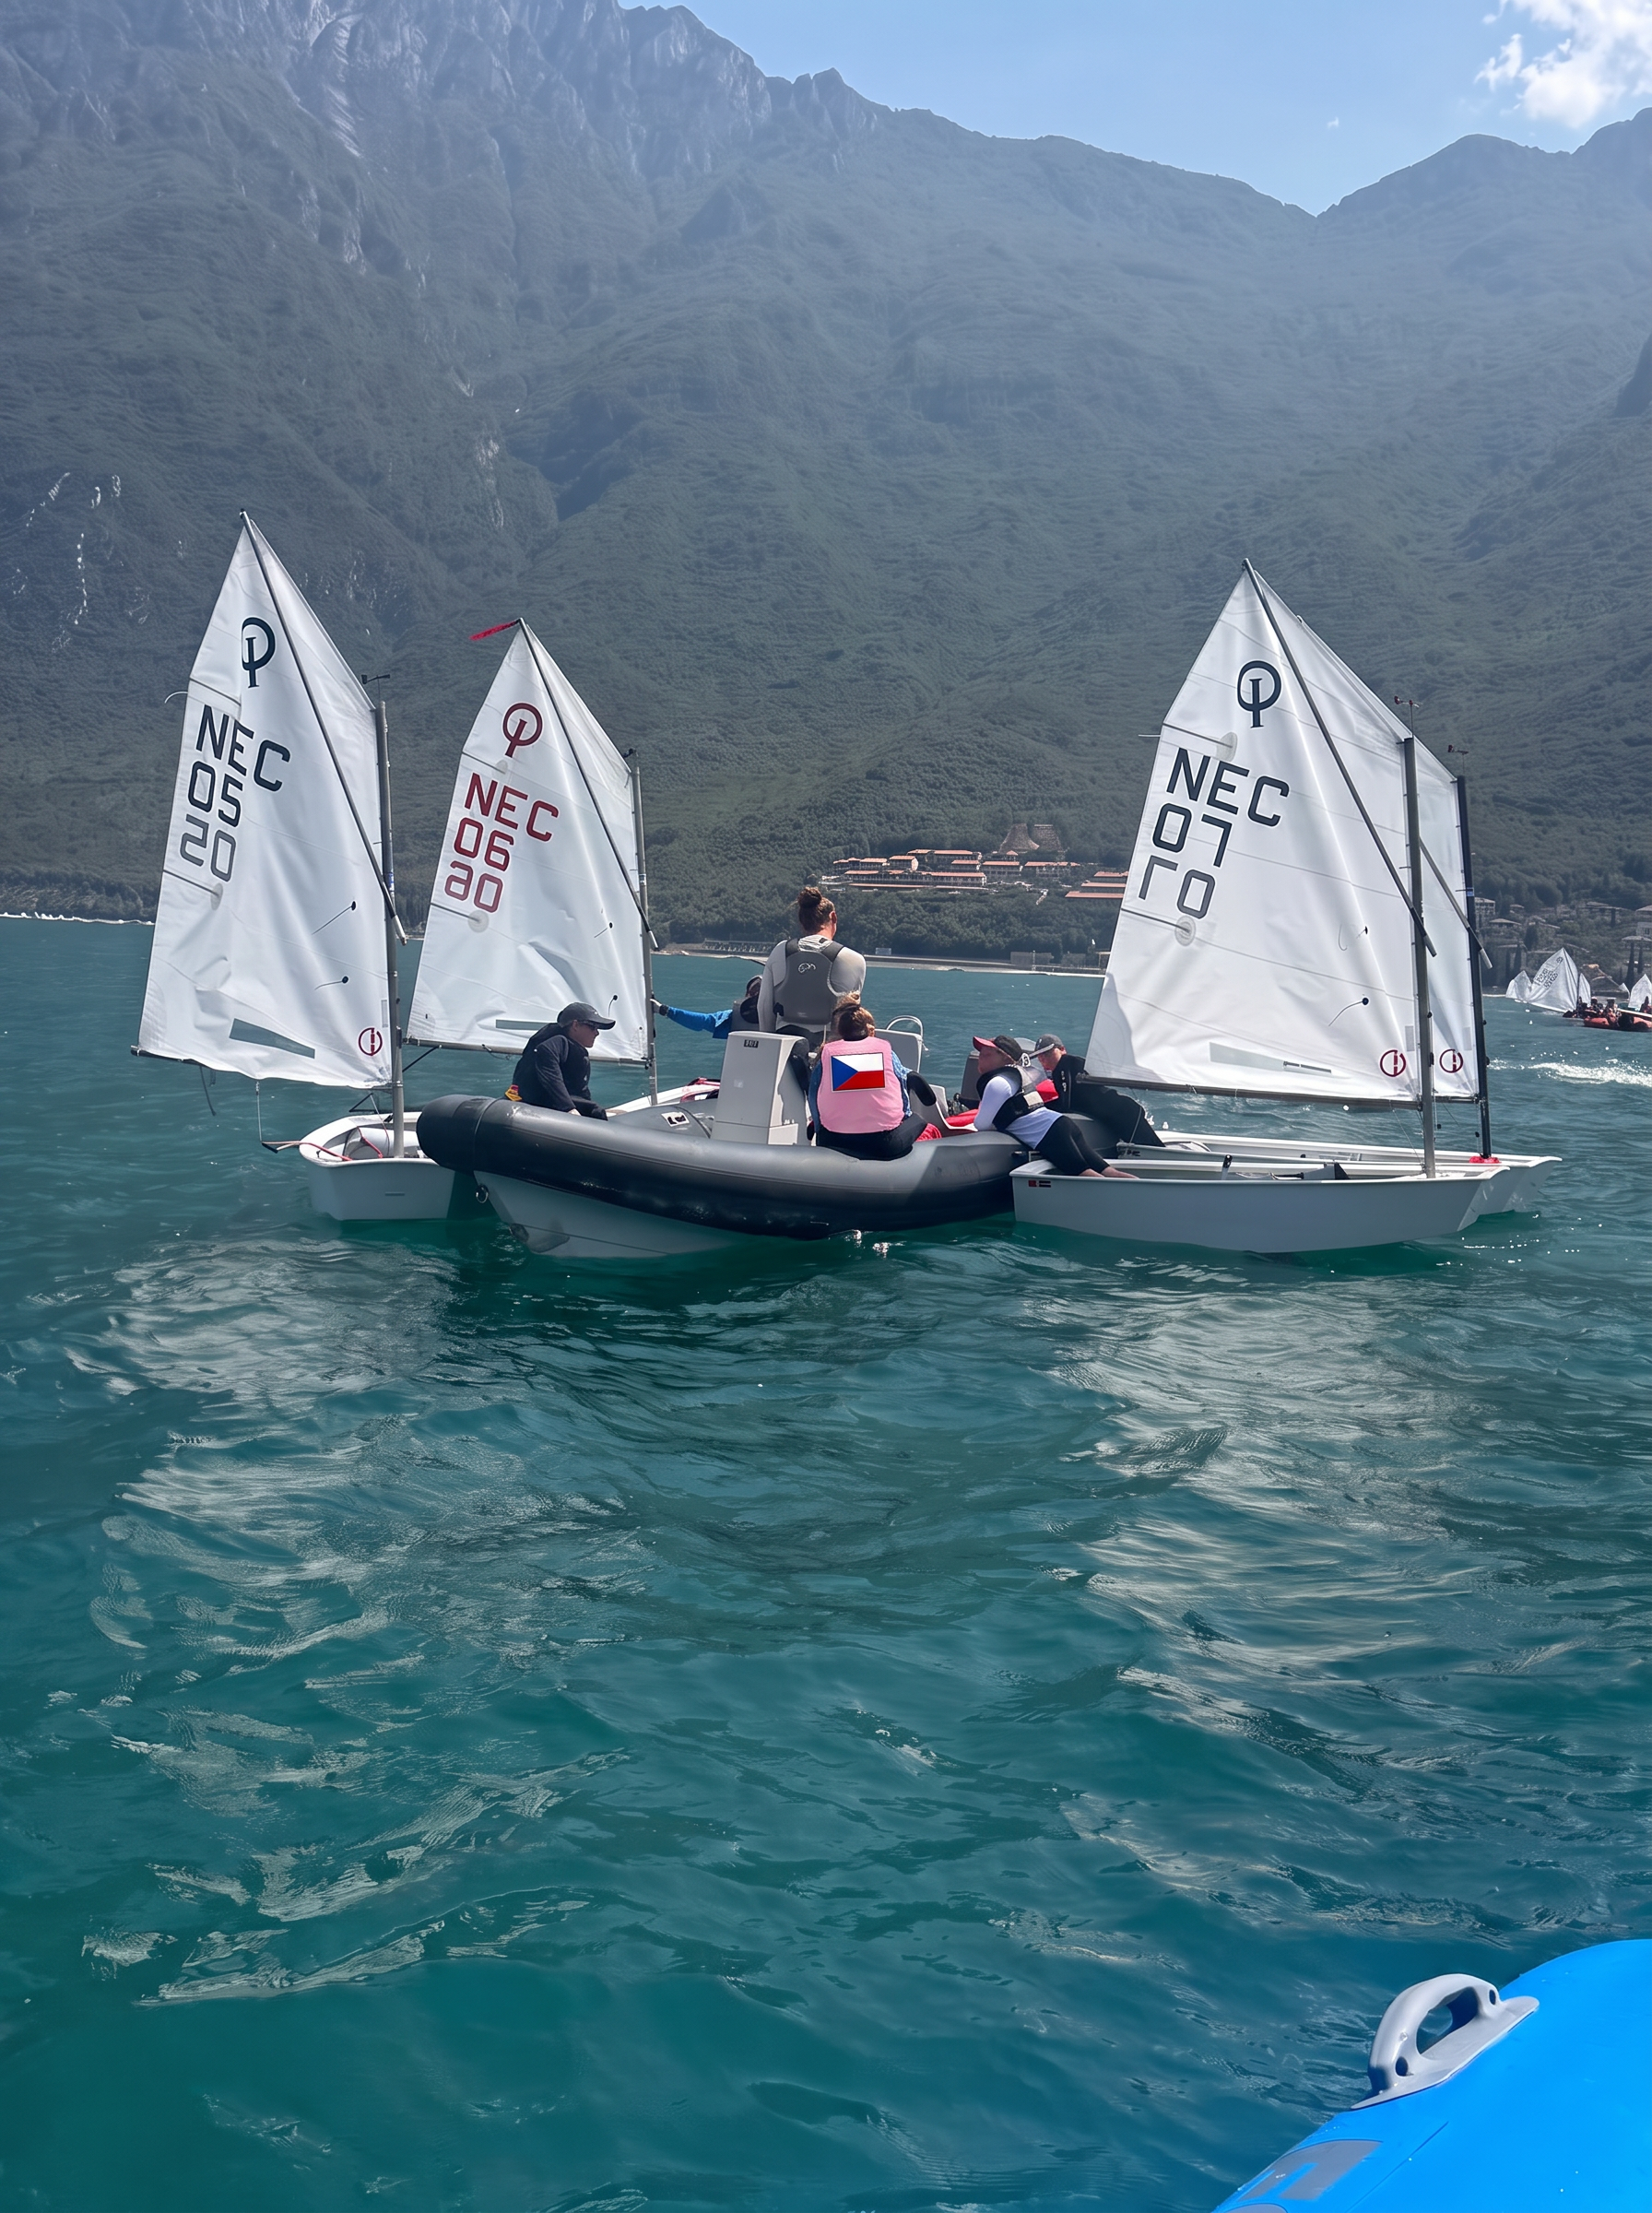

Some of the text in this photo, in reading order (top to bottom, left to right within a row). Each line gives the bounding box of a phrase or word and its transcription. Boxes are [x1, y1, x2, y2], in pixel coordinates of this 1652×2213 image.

[196, 704, 290, 791] NEC
[188, 761, 243, 827] 05
[465, 773, 559, 842] NEC
[1166, 748, 1290, 827] NEC
[454, 817, 514, 871] 06
[1152, 803, 1233, 868] 07
